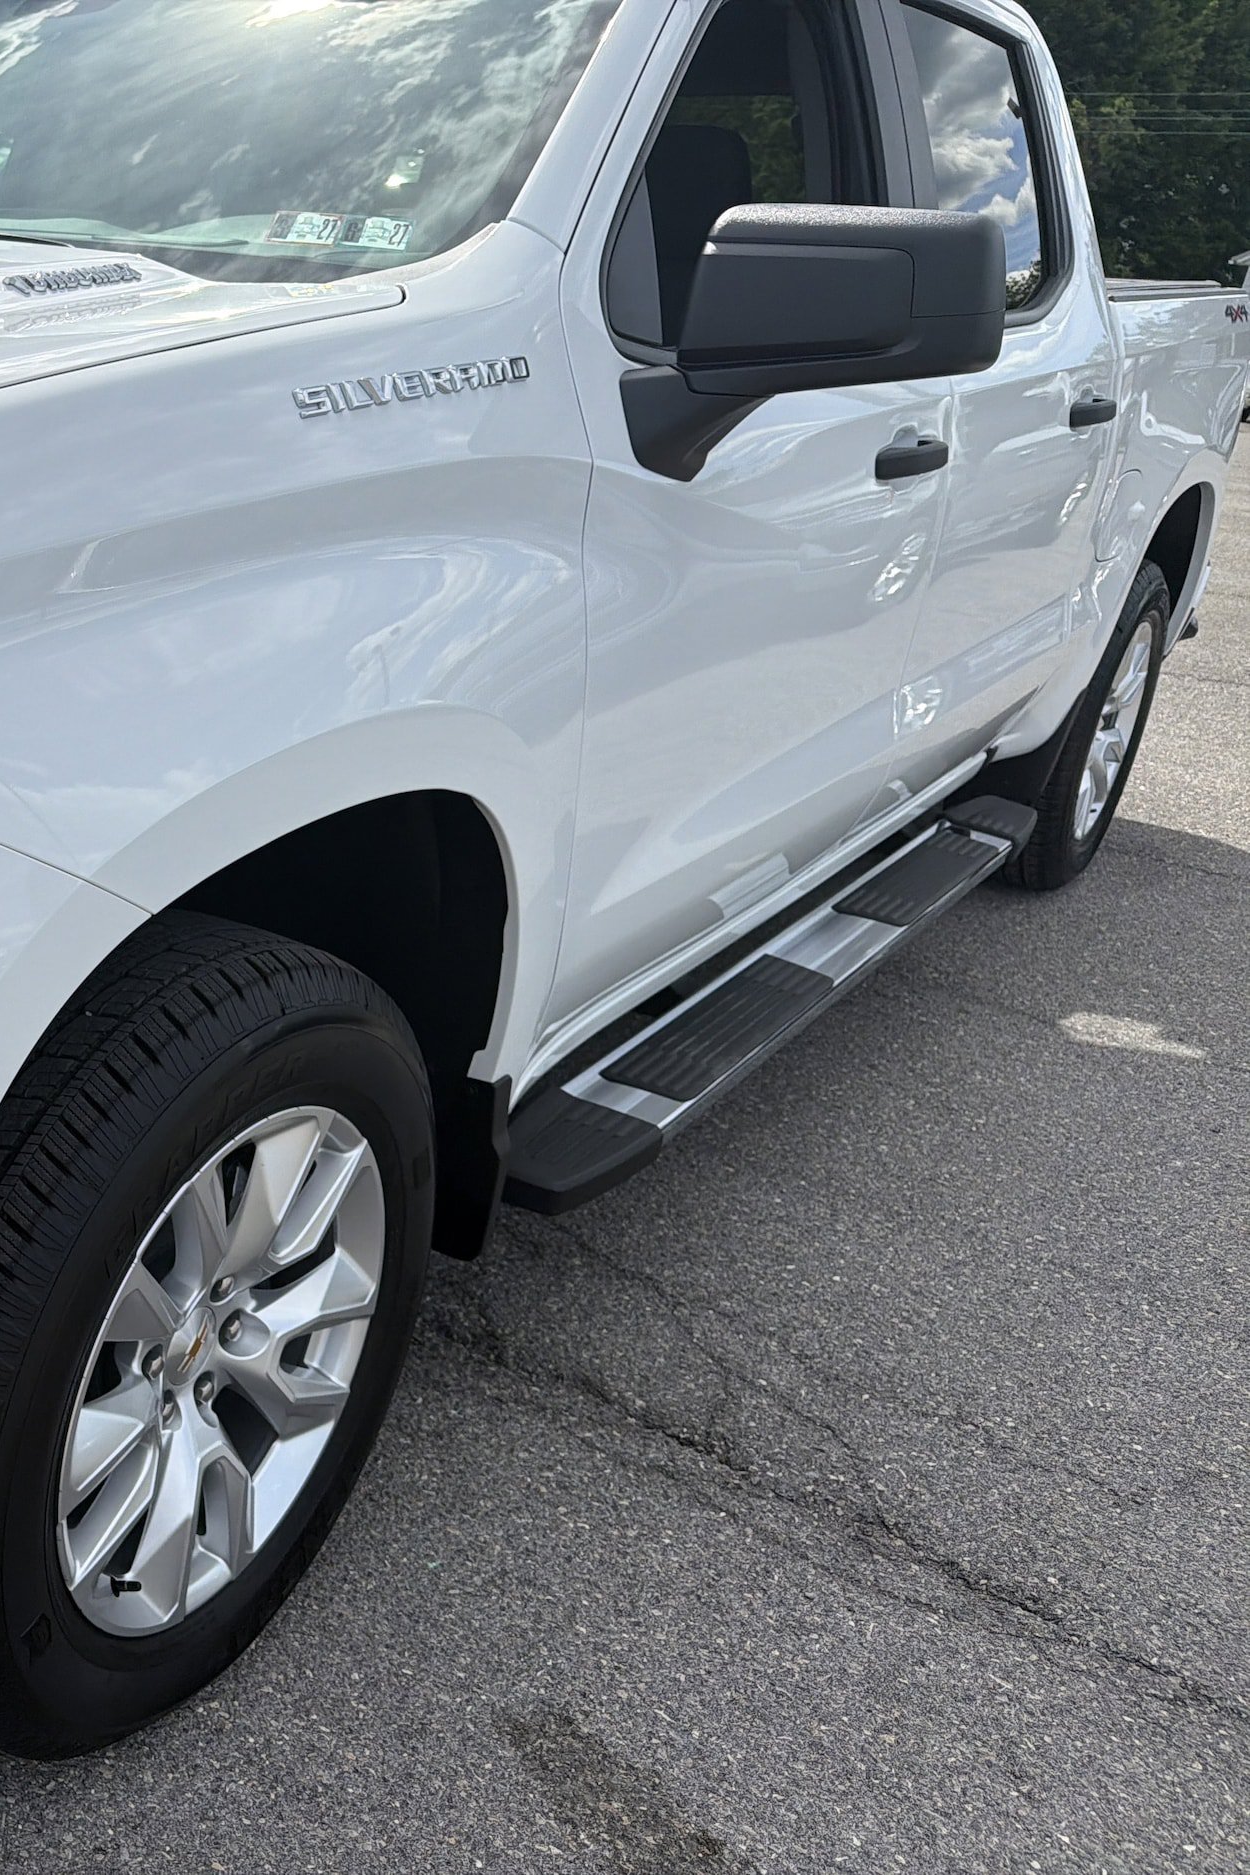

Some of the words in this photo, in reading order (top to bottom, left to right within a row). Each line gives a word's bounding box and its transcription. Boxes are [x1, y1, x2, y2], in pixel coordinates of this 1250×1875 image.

[317, 218, 338, 242] 27
[388, 223, 410, 248] 27
[292, 356, 530, 419] SILVERADO
